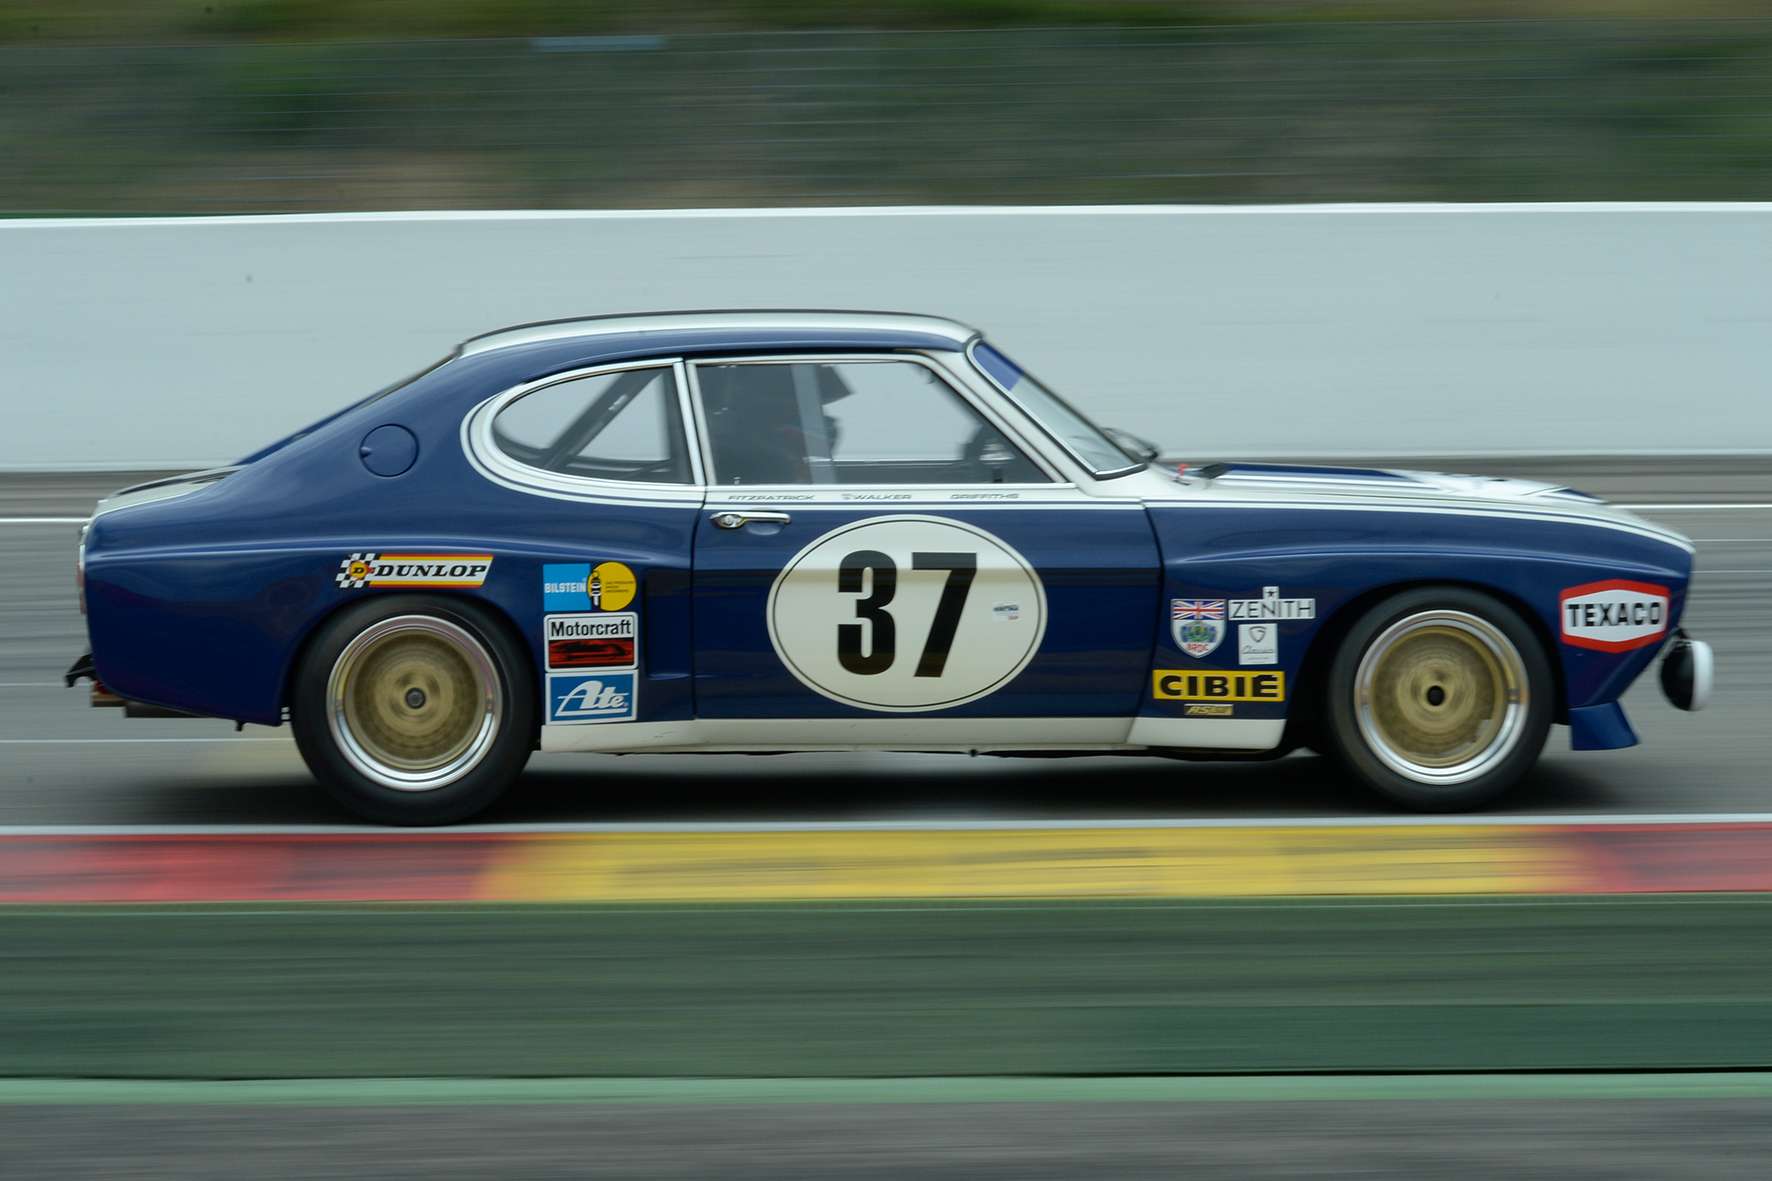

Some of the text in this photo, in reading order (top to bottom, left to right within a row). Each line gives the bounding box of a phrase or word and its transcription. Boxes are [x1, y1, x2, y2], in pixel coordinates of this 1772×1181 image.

[373, 564, 487, 578] DUNLOP
[544, 582, 586, 593] BILSTEIN
[837, 549, 979, 678] 37
[1230, 600, 1313, 619] ZENITH
[1566, 602, 1661, 627] TEXACO
[551, 618, 631, 637] Motorcraft
[555, 680, 629, 717] Ate
